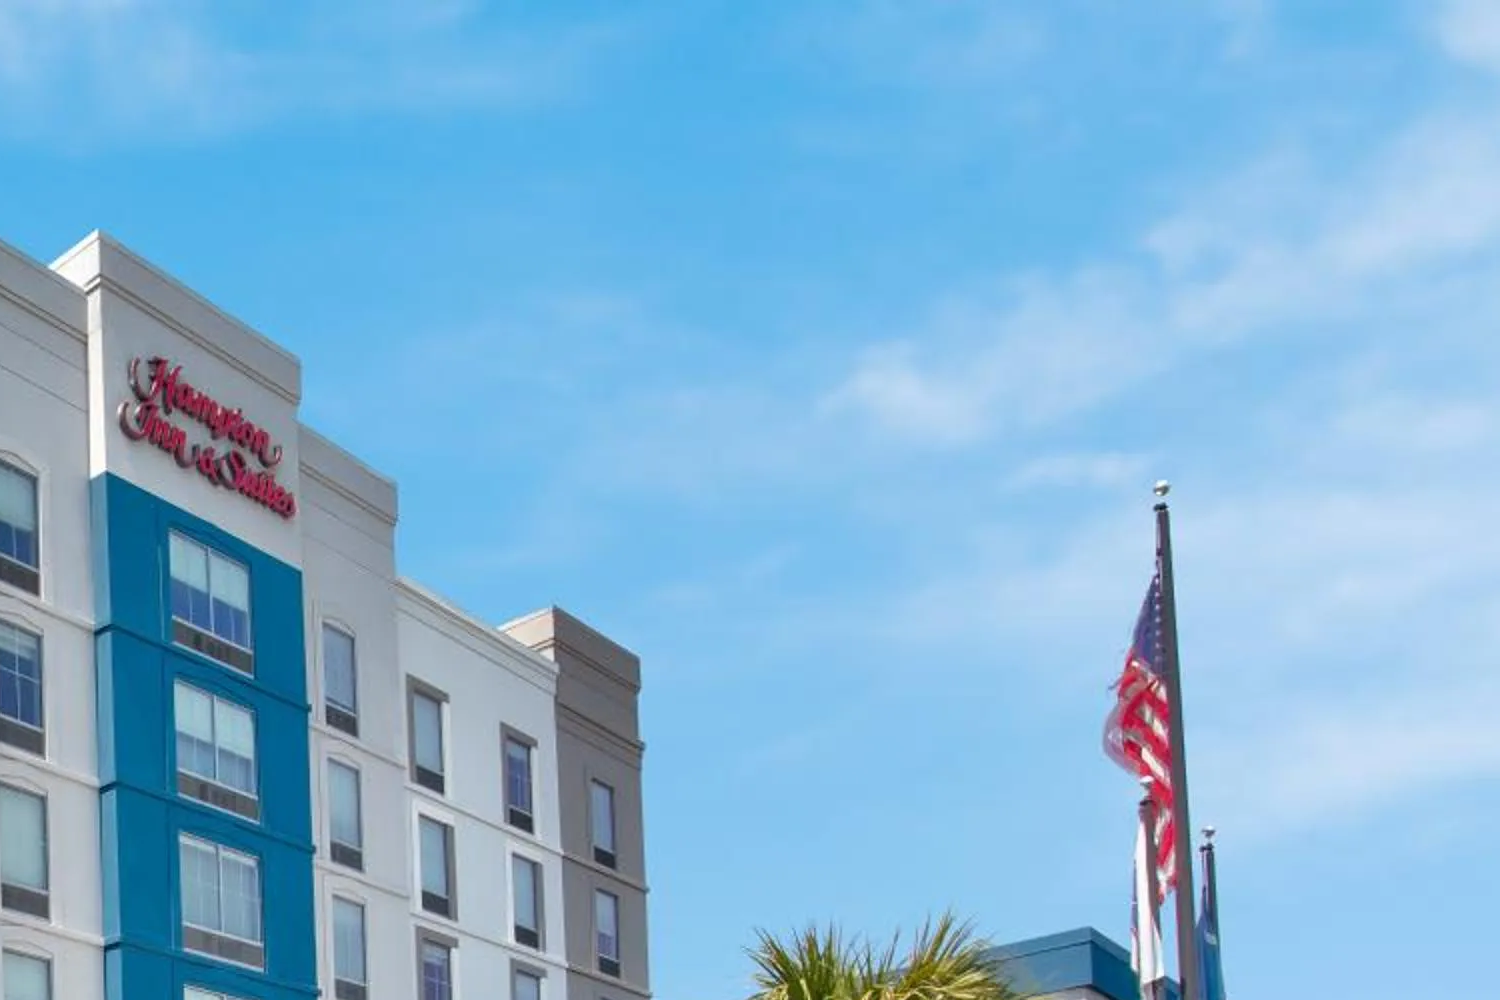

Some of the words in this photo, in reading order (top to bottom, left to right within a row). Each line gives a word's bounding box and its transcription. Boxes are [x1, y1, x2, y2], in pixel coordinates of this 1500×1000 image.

[117, 401, 198, 468] Inn
[197, 447, 220, 485] &
[216, 450, 296, 519] Suites
[128, 355, 283, 468] Hampton
